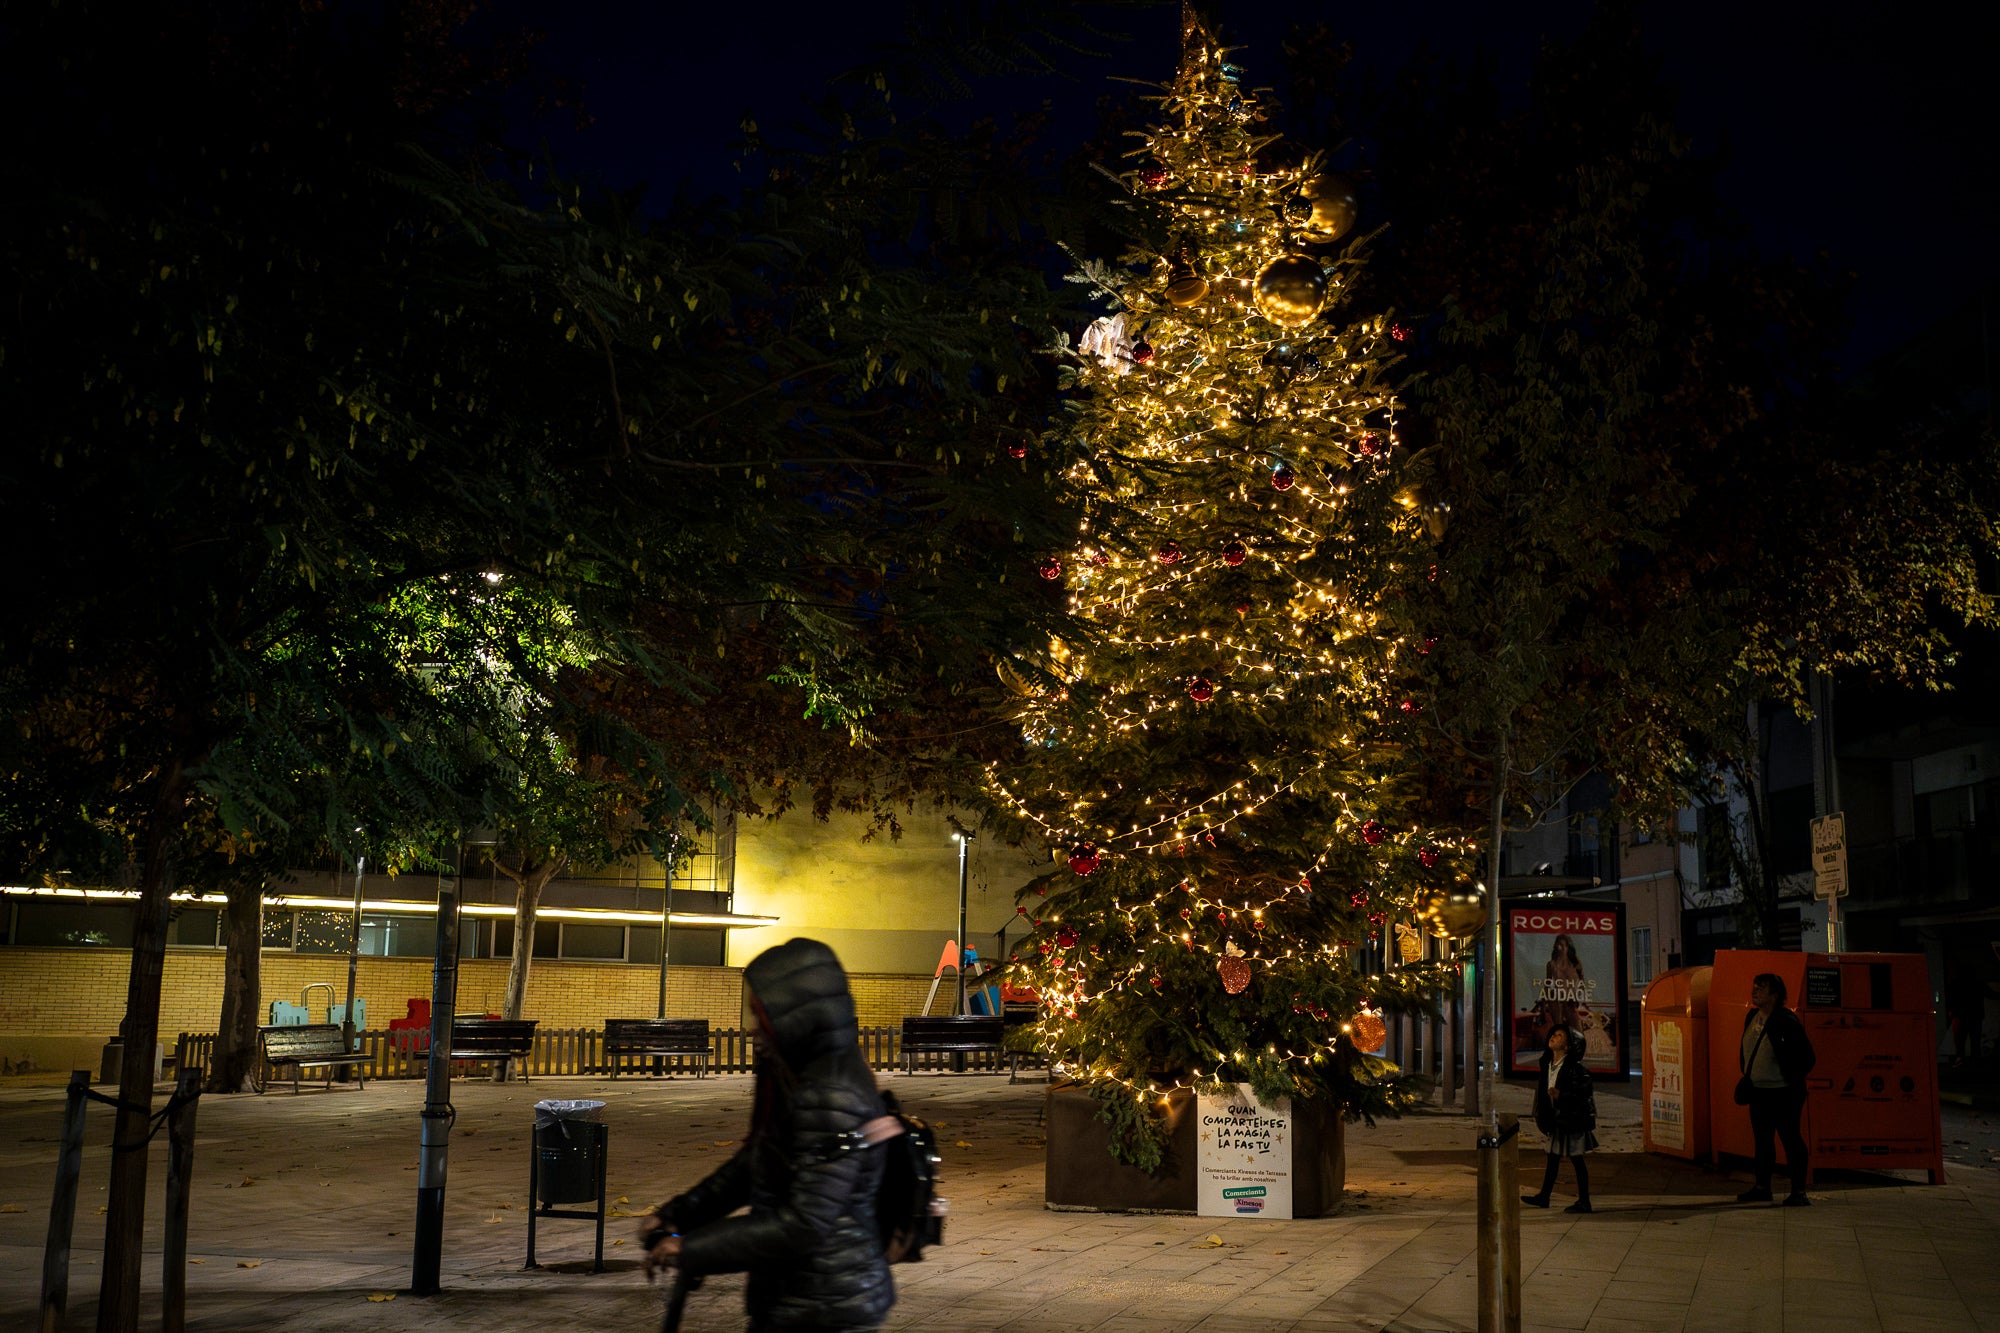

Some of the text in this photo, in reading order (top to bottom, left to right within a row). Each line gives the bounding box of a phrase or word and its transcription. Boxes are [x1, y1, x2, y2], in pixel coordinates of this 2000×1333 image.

[1513, 915, 1613, 931] ROCHAS
[1532, 978, 1597, 989] ROCHAS
[1228, 1105, 1256, 1115] QUAN
[1218, 1127, 1231, 1138] LA
[1218, 1139, 1270, 1149] LA FAS TU
[1225, 1188, 1264, 1197] Comerciants
[1236, 1198, 1262, 1207] Xinesos
